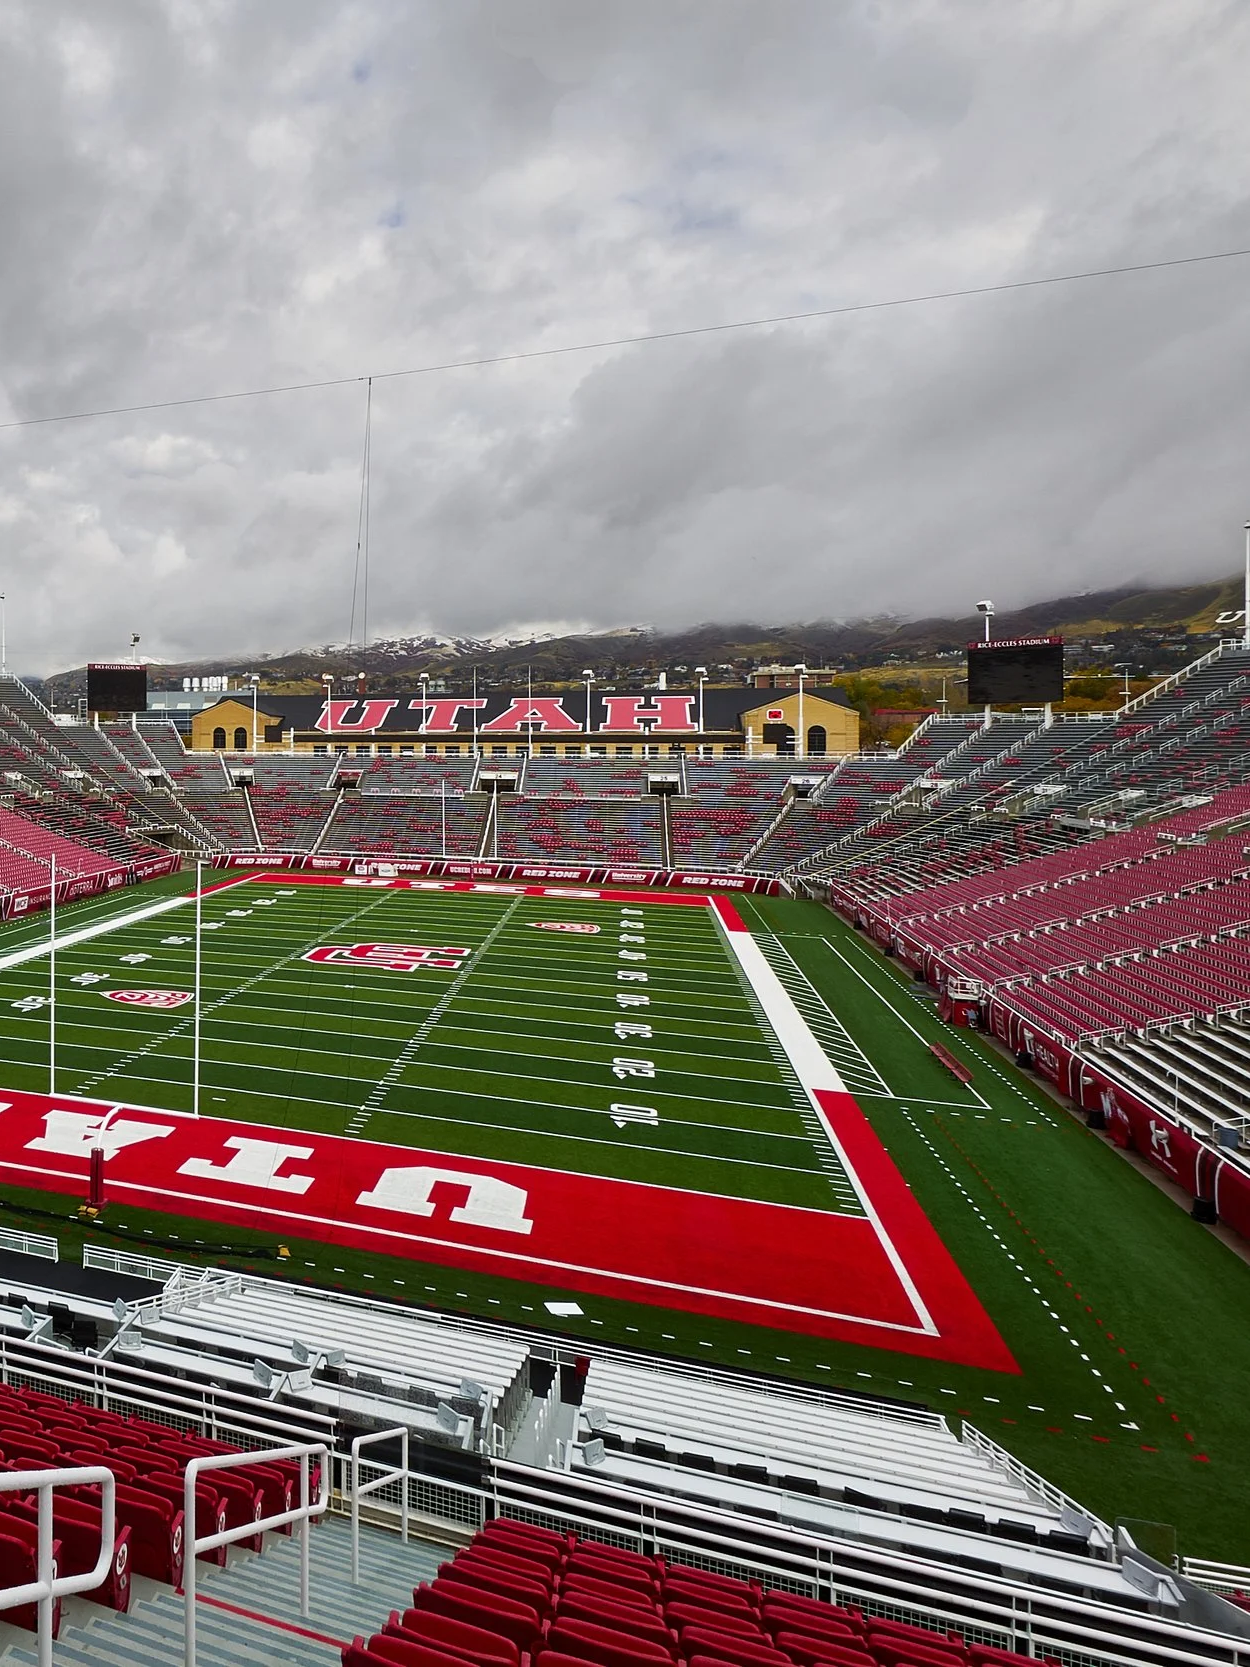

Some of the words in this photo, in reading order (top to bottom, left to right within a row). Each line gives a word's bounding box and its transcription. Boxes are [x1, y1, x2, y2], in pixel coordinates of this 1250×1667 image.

[977, 639, 1017, 649] RICE-ECCLES
[1018, 638, 1050, 647] STADIUM
[314, 696, 700, 733] UTAH
[235, 857, 251, 865] RED
[252, 858, 284, 866] ZONE
[522, 869, 548, 877] RED
[548, 870, 581, 879] ZONE
[681, 876, 707, 885] RED
[709, 879, 745, 888] ZONE
[342, 878, 600, 899] UTES
[612, 1057, 656, 1078] 20
[610, 1103, 659, 1127] 10
